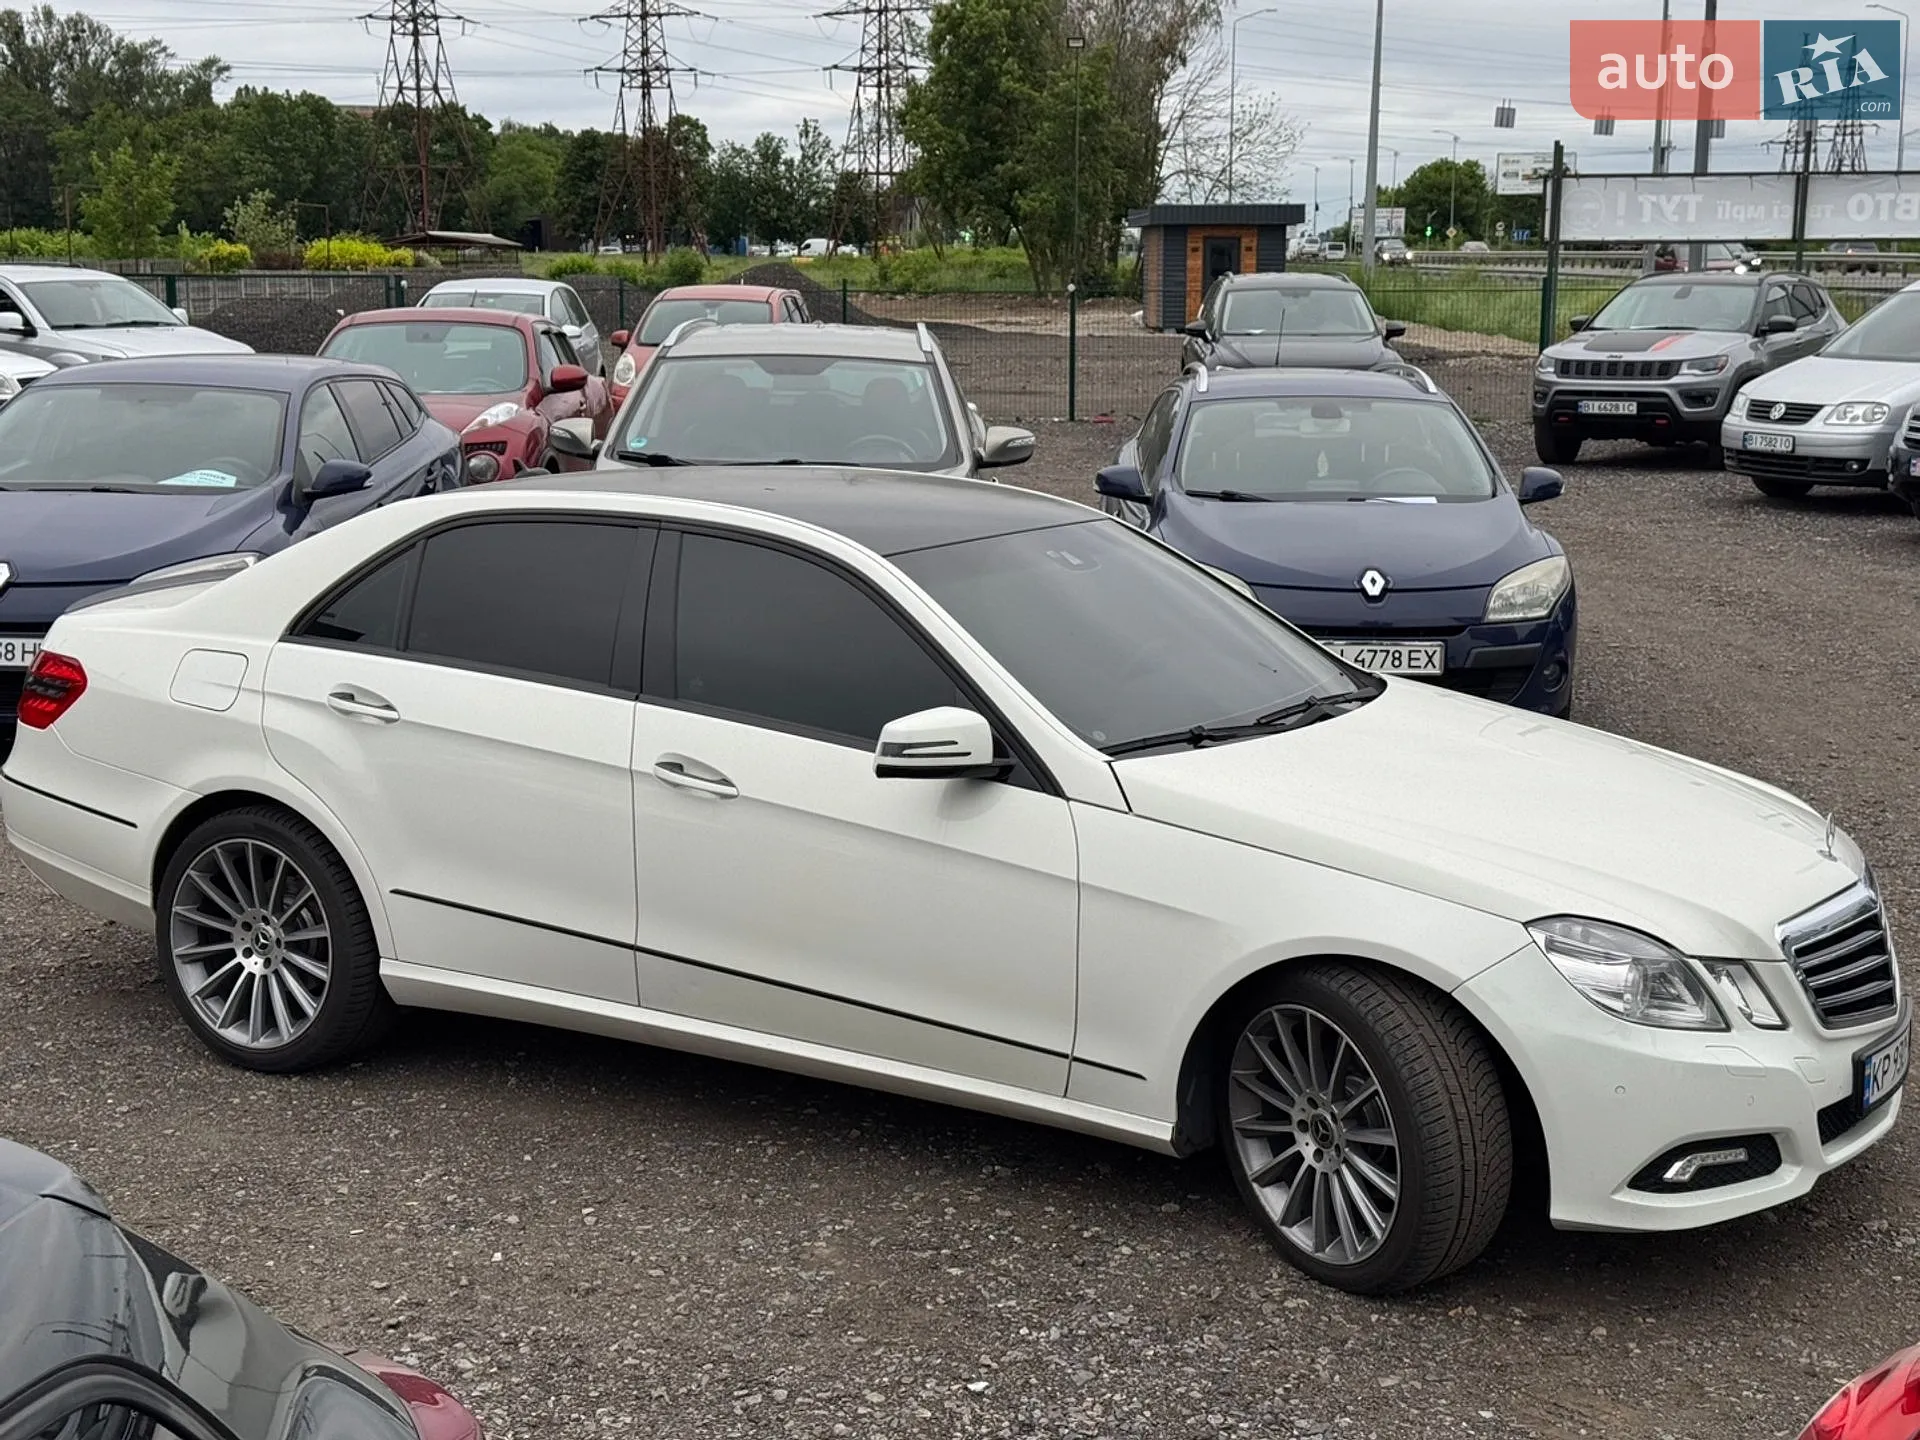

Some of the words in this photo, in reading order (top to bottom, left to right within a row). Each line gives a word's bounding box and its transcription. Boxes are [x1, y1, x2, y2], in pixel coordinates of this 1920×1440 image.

[22, 642, 42, 662] H
[1354, 649, 1402, 668] 4778
[1408, 649, 1437, 669] EX
[1871, 1053, 1890, 1096] KP
